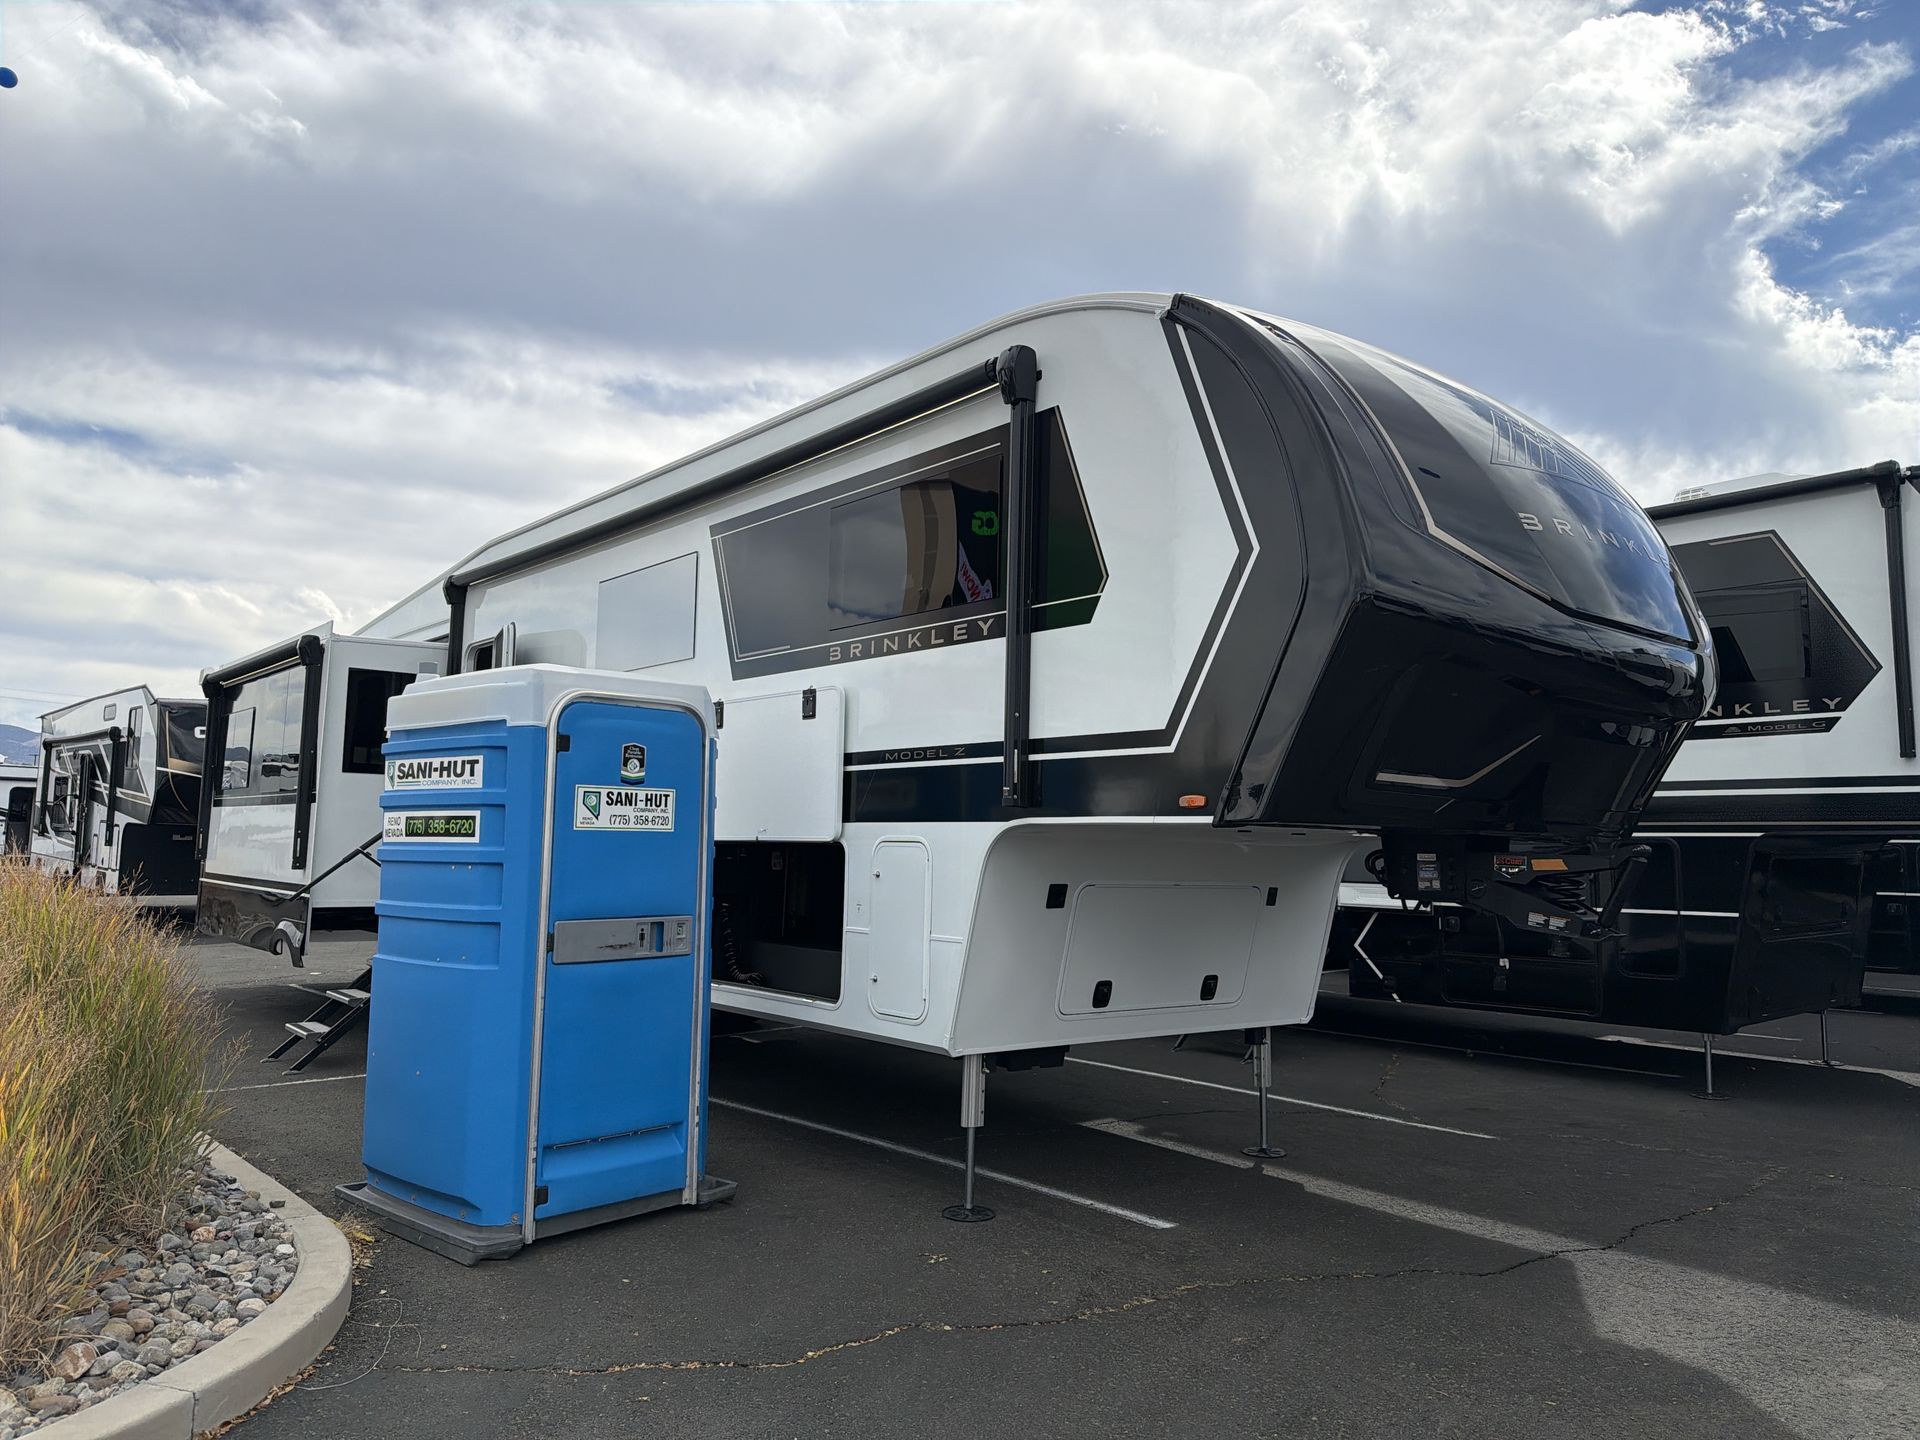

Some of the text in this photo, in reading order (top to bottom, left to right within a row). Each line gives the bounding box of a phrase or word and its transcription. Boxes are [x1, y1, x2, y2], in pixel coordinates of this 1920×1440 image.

[1518, 512, 1676, 573] BRINKLE
[829, 618, 995, 662] BRINKLEY
[1748, 723, 1807, 732] MODEL
[885, 747, 966, 760] MODEL Z
[397, 759, 480, 780] SANI-HUT
[606, 791, 670, 808] SANI-HUT
[388, 816, 401, 826] RENO
[406, 819, 474, 835] (775) 358-6720
[609, 814, 670, 826] (775) 358-6720
[385, 828, 404, 838] NEVADA
